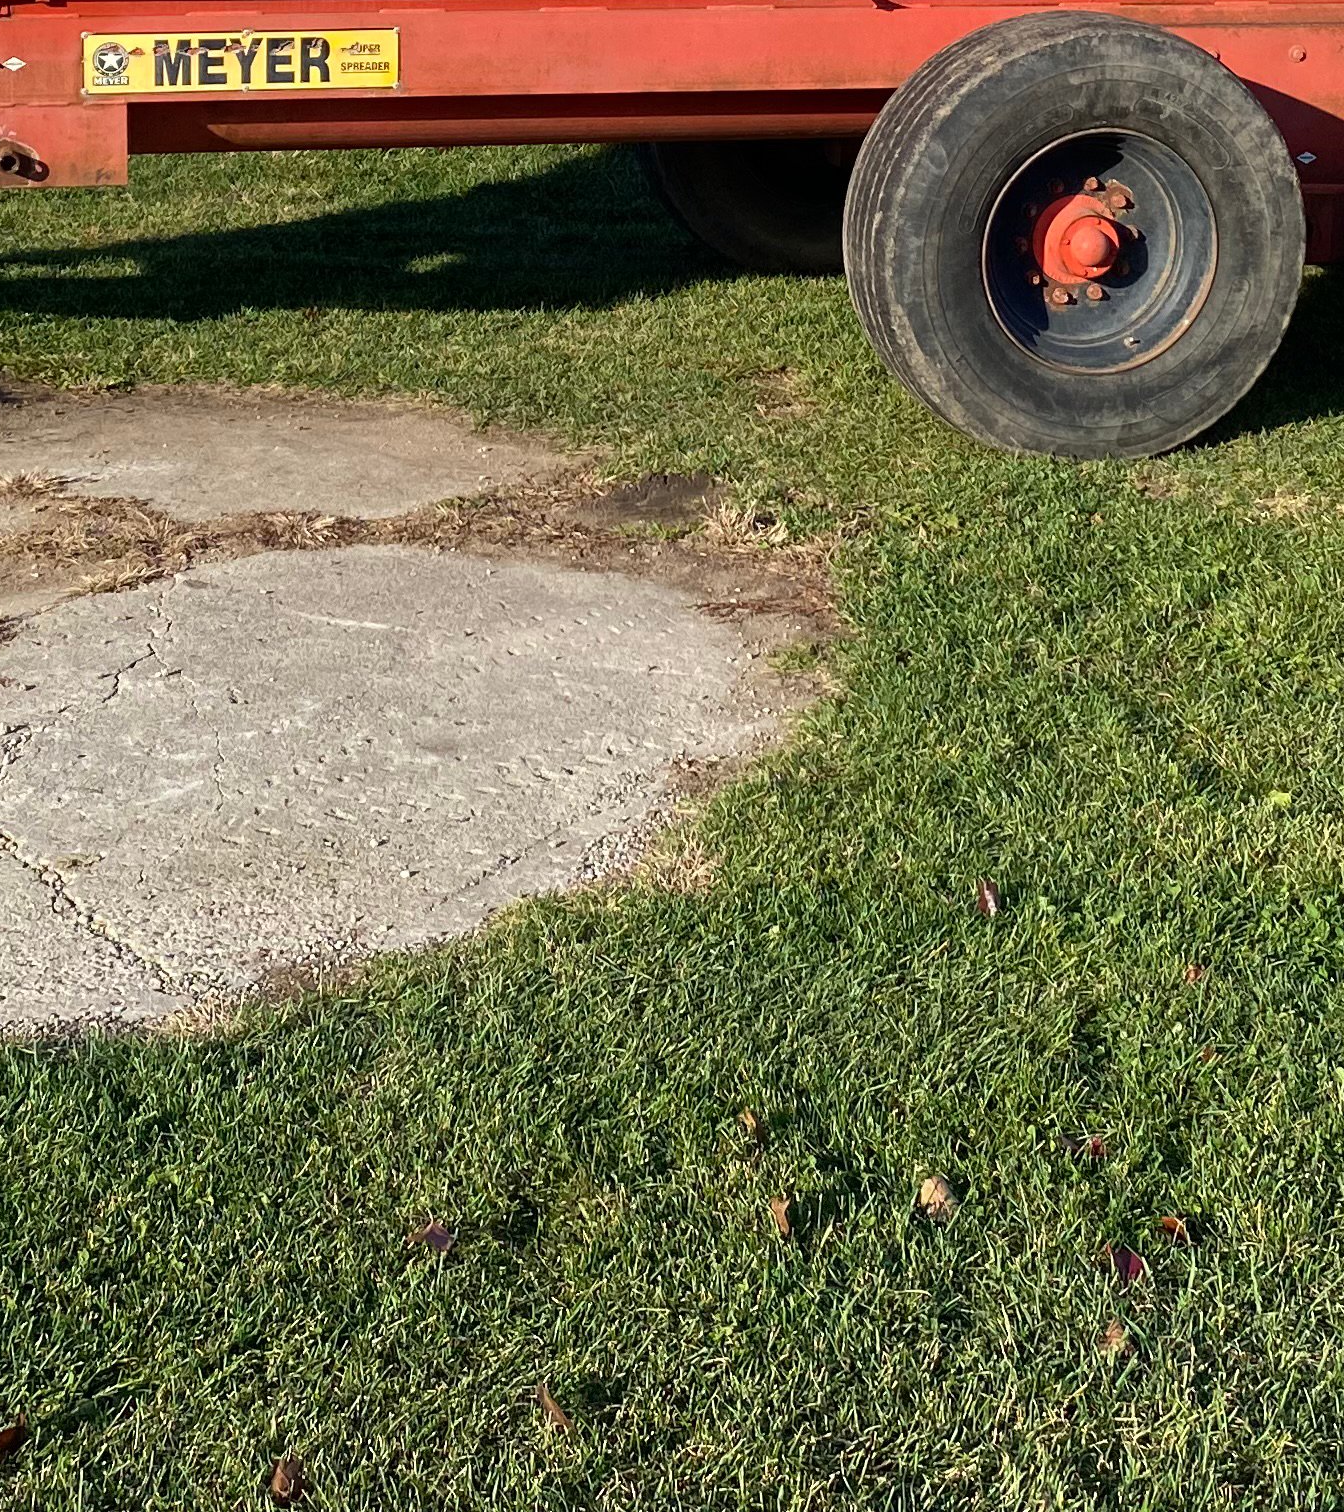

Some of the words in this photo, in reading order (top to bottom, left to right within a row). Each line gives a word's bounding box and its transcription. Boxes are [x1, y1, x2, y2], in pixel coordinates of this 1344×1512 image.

[350, 43, 381, 54] UPER
[153, 36, 331, 87] MEYER
[340, 61, 391, 71] SPREADER
[93, 76, 129, 86] MEYER
